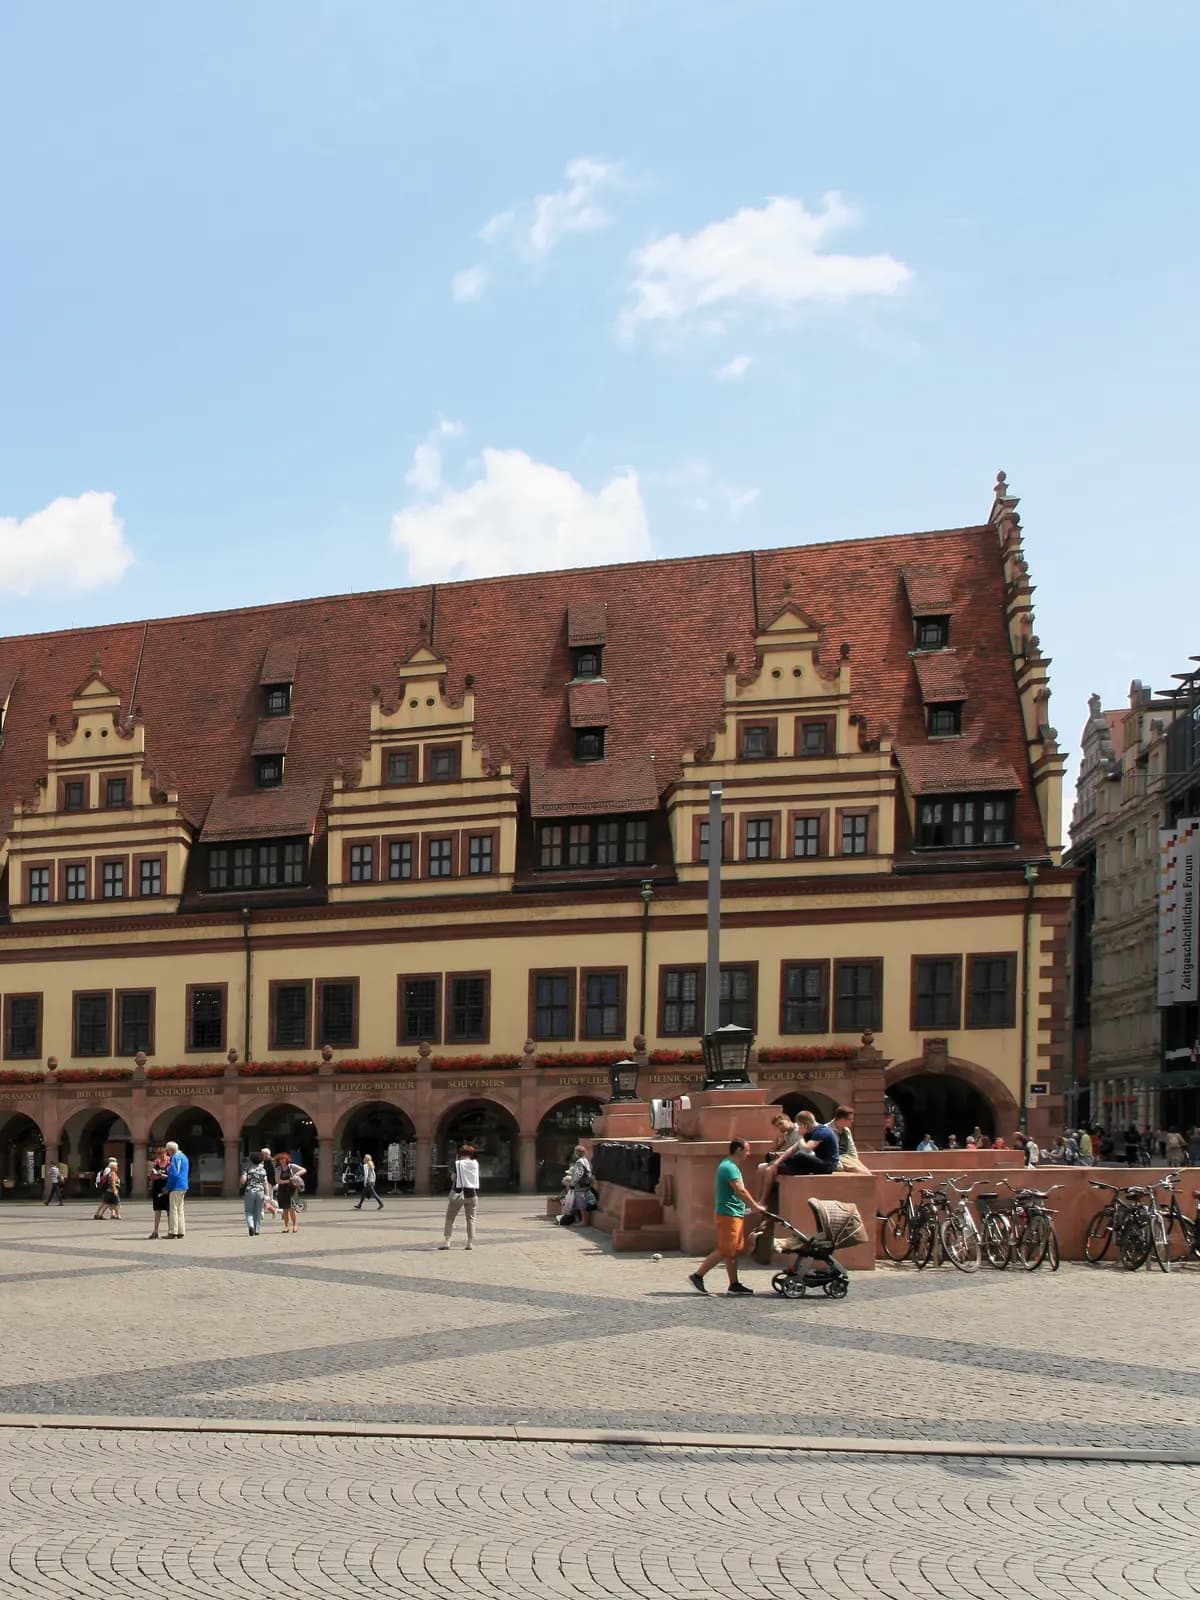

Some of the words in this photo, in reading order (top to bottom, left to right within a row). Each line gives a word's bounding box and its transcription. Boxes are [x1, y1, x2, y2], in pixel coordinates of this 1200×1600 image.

[1182, 854, 1193, 889] Forum
[1180, 890, 1193, 990] Zeitgeschichtliches
[763, 1071, 795, 1081] GOLD
[796, 1071, 806, 1080] &
[256, 1083, 300, 1094] GRAPHIK
[447, 1079, 504, 1088] SOUVENIRS
[154, 1087, 216, 1096] ANTIQUARIAT
